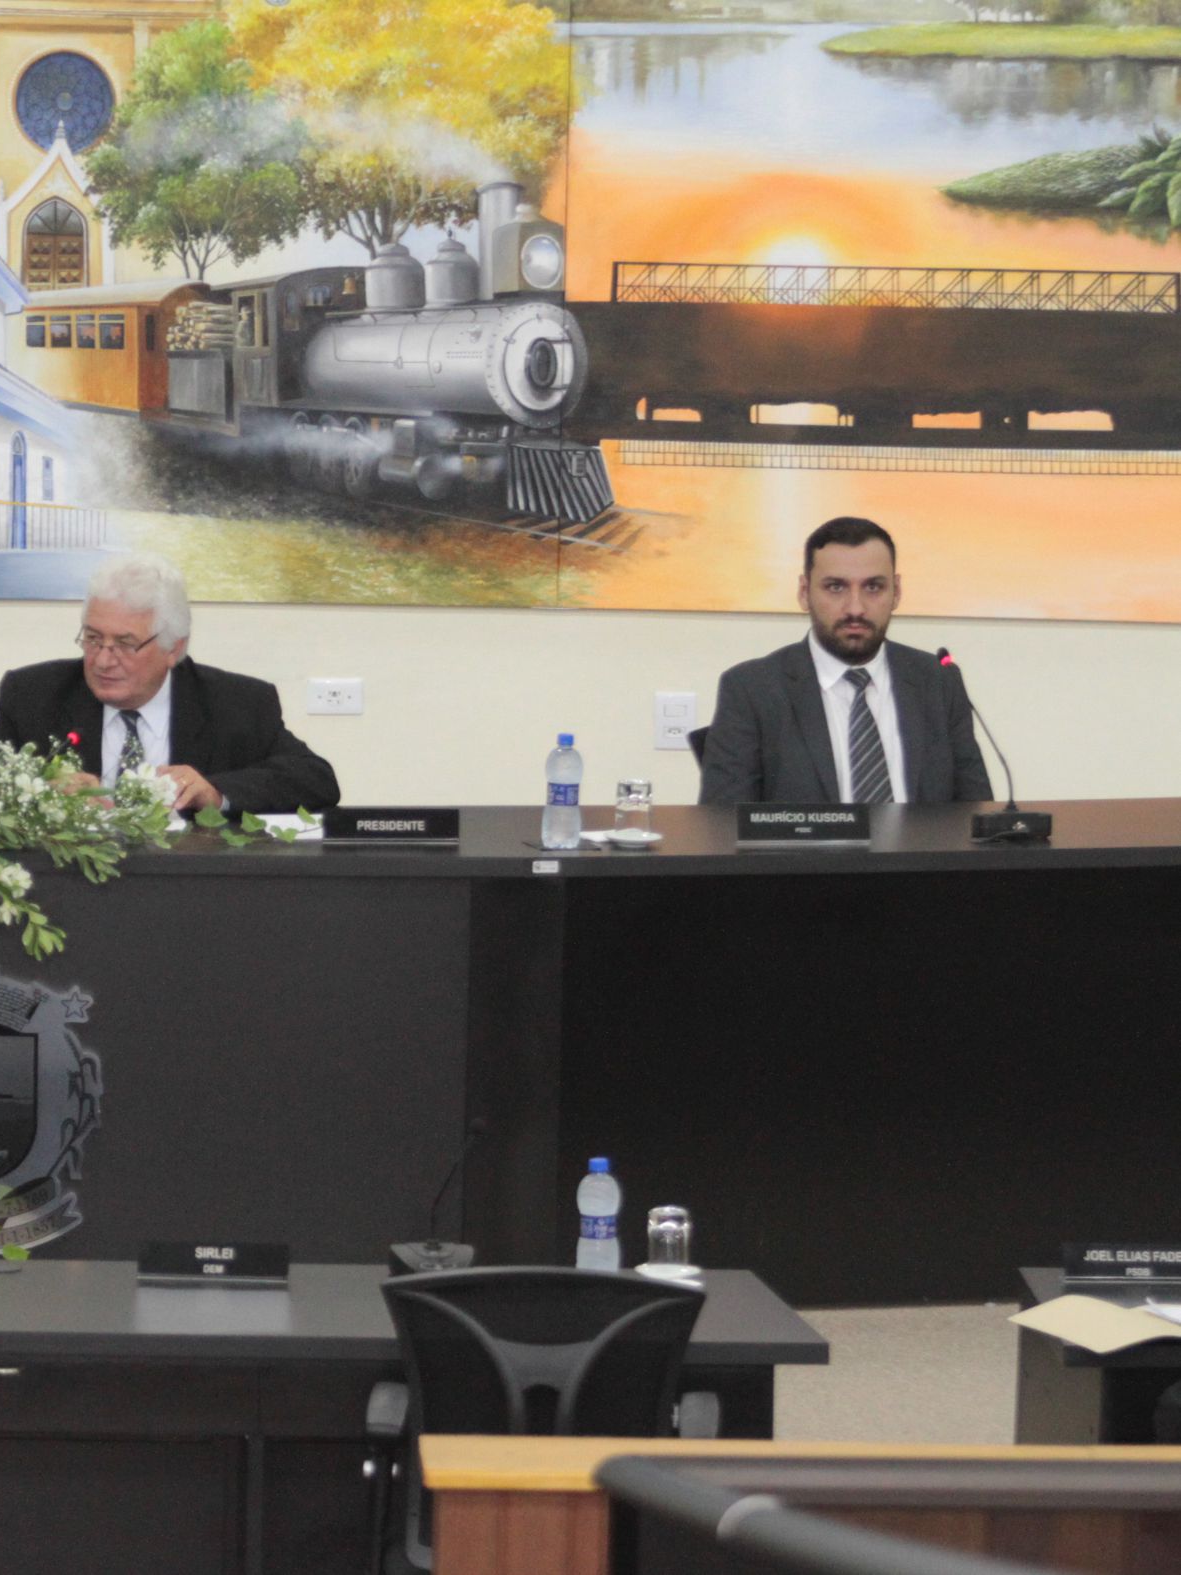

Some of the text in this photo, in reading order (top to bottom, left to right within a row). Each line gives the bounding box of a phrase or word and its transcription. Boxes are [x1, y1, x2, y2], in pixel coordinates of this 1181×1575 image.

[750, 811, 855, 823] MAURÍCIO KUSDRA
[356, 820, 426, 831] PRESIDENTE
[195, 1247, 234, 1259] SIRLEI
[1083, 1250, 1114, 1261] JOEL
[1116, 1251, 1150, 1262] ELIAS
[203, 1264, 225, 1274] DEM
